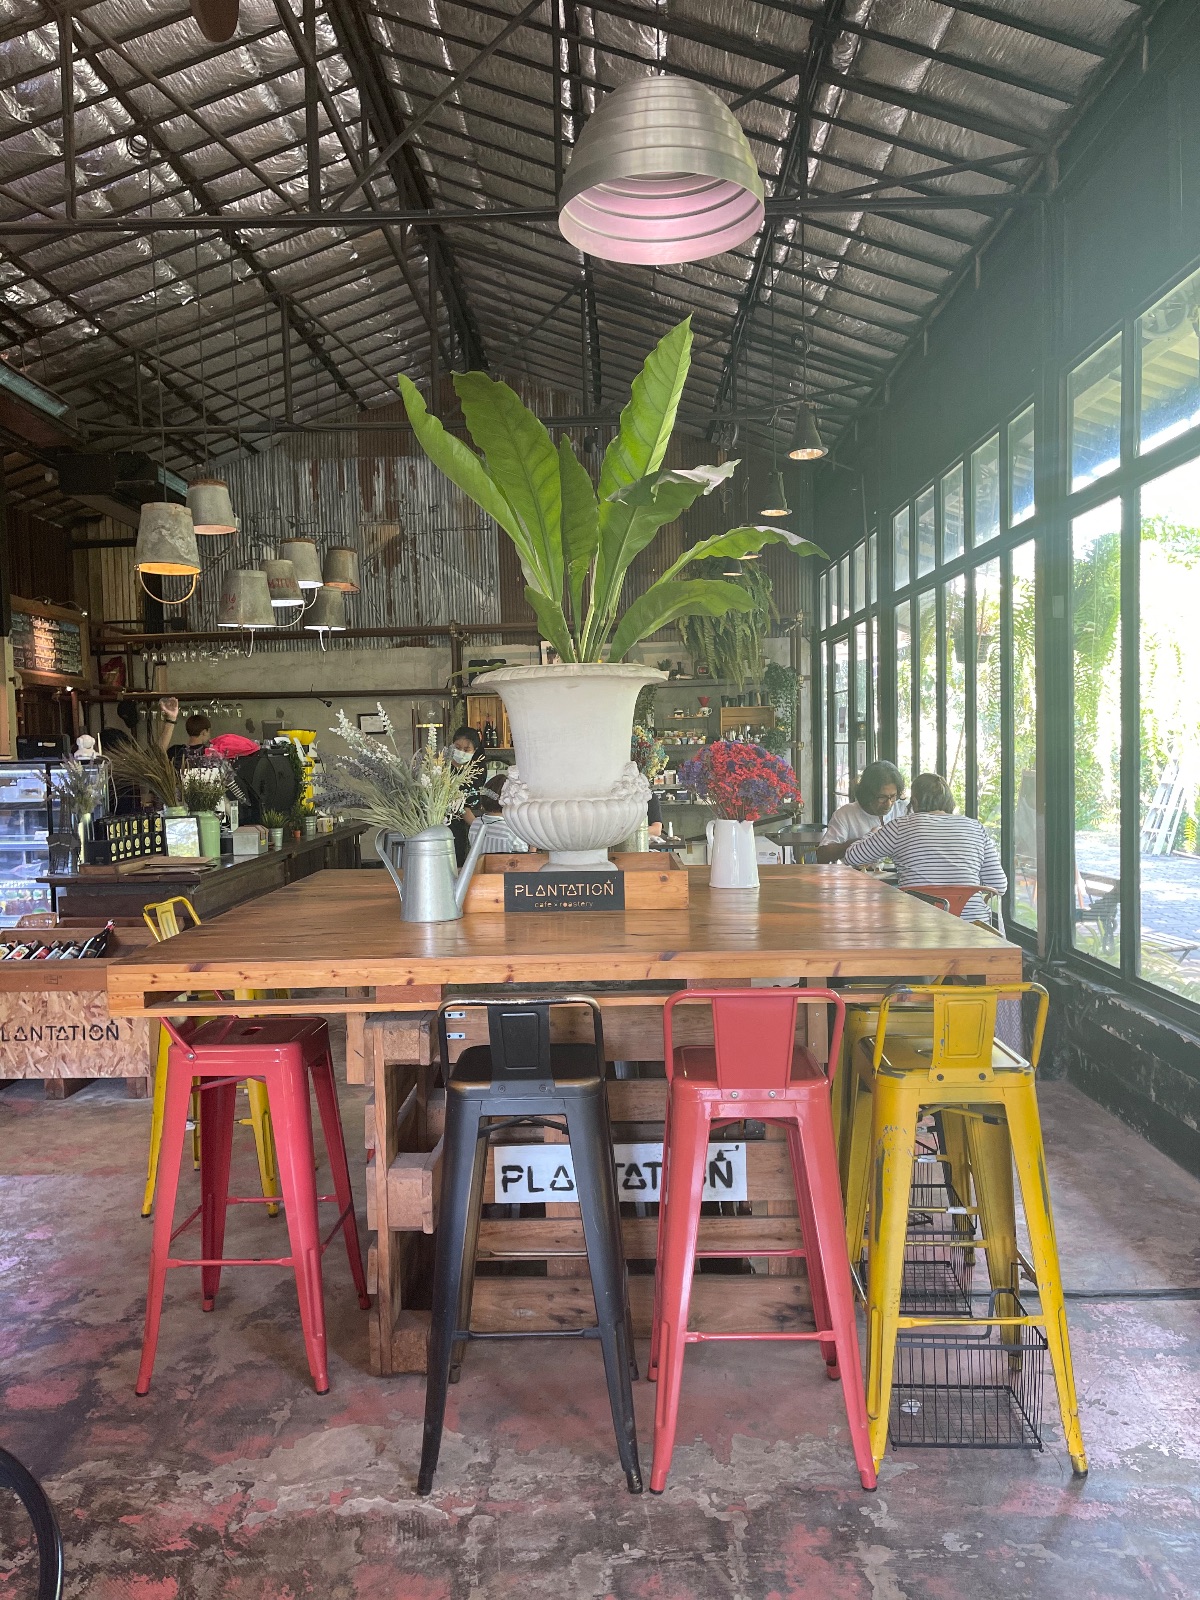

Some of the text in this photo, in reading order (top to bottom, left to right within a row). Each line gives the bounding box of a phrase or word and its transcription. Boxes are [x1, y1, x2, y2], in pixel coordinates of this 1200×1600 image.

[514, 883, 614, 897] PLANTATION
[1, 1024, 119, 1041] LANTATION
[501, 1161, 733, 1193] PLAATN
